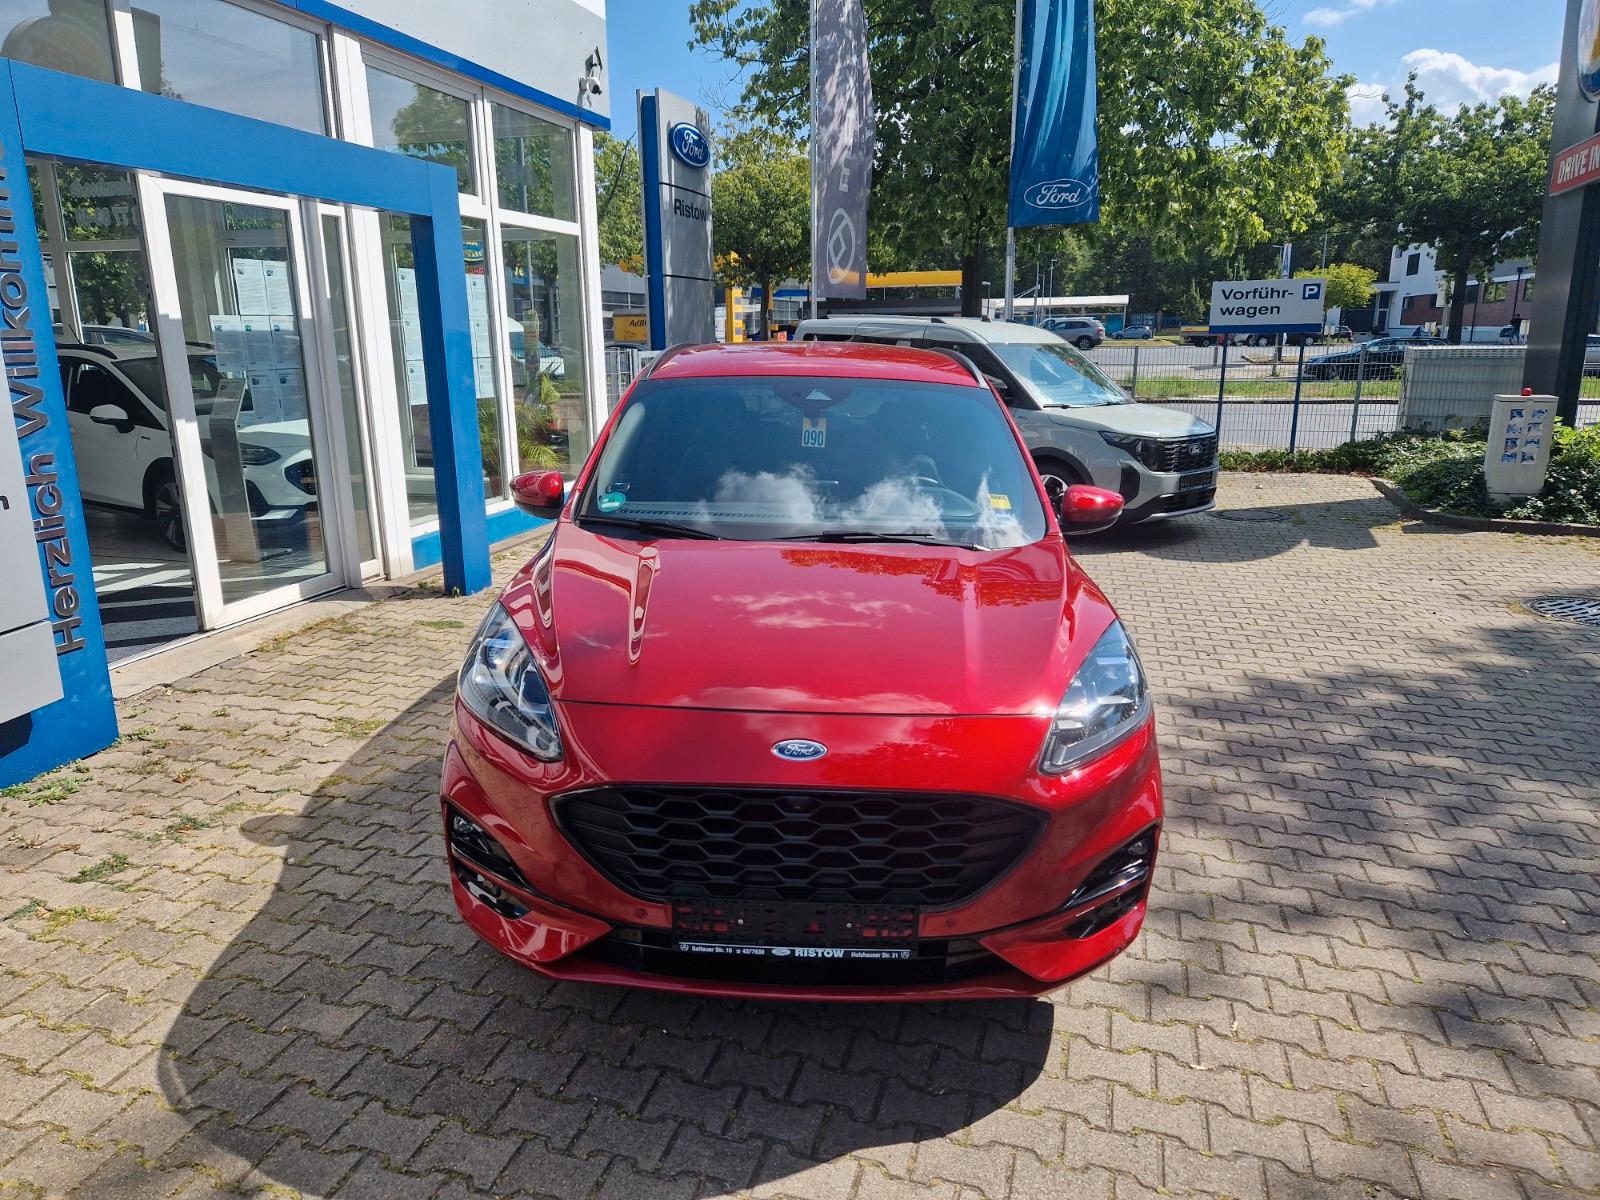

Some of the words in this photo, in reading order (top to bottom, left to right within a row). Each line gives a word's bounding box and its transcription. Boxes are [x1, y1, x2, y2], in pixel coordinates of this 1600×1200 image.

[680, 129, 705, 160] Ford
[1557, 148, 1589, 184] DRIVE
[1036, 183, 1081, 205] Ford
[674, 198, 707, 223] Ristow
[1221, 286, 1294, 301] Vorführ-
[1220, 305, 1281, 318] wagen
[803, 430, 824, 446] 090
[25, 453, 86, 655] Herzlich
[785, 743, 814, 755] Ford
[795, 948, 844, 958] RISTOW
